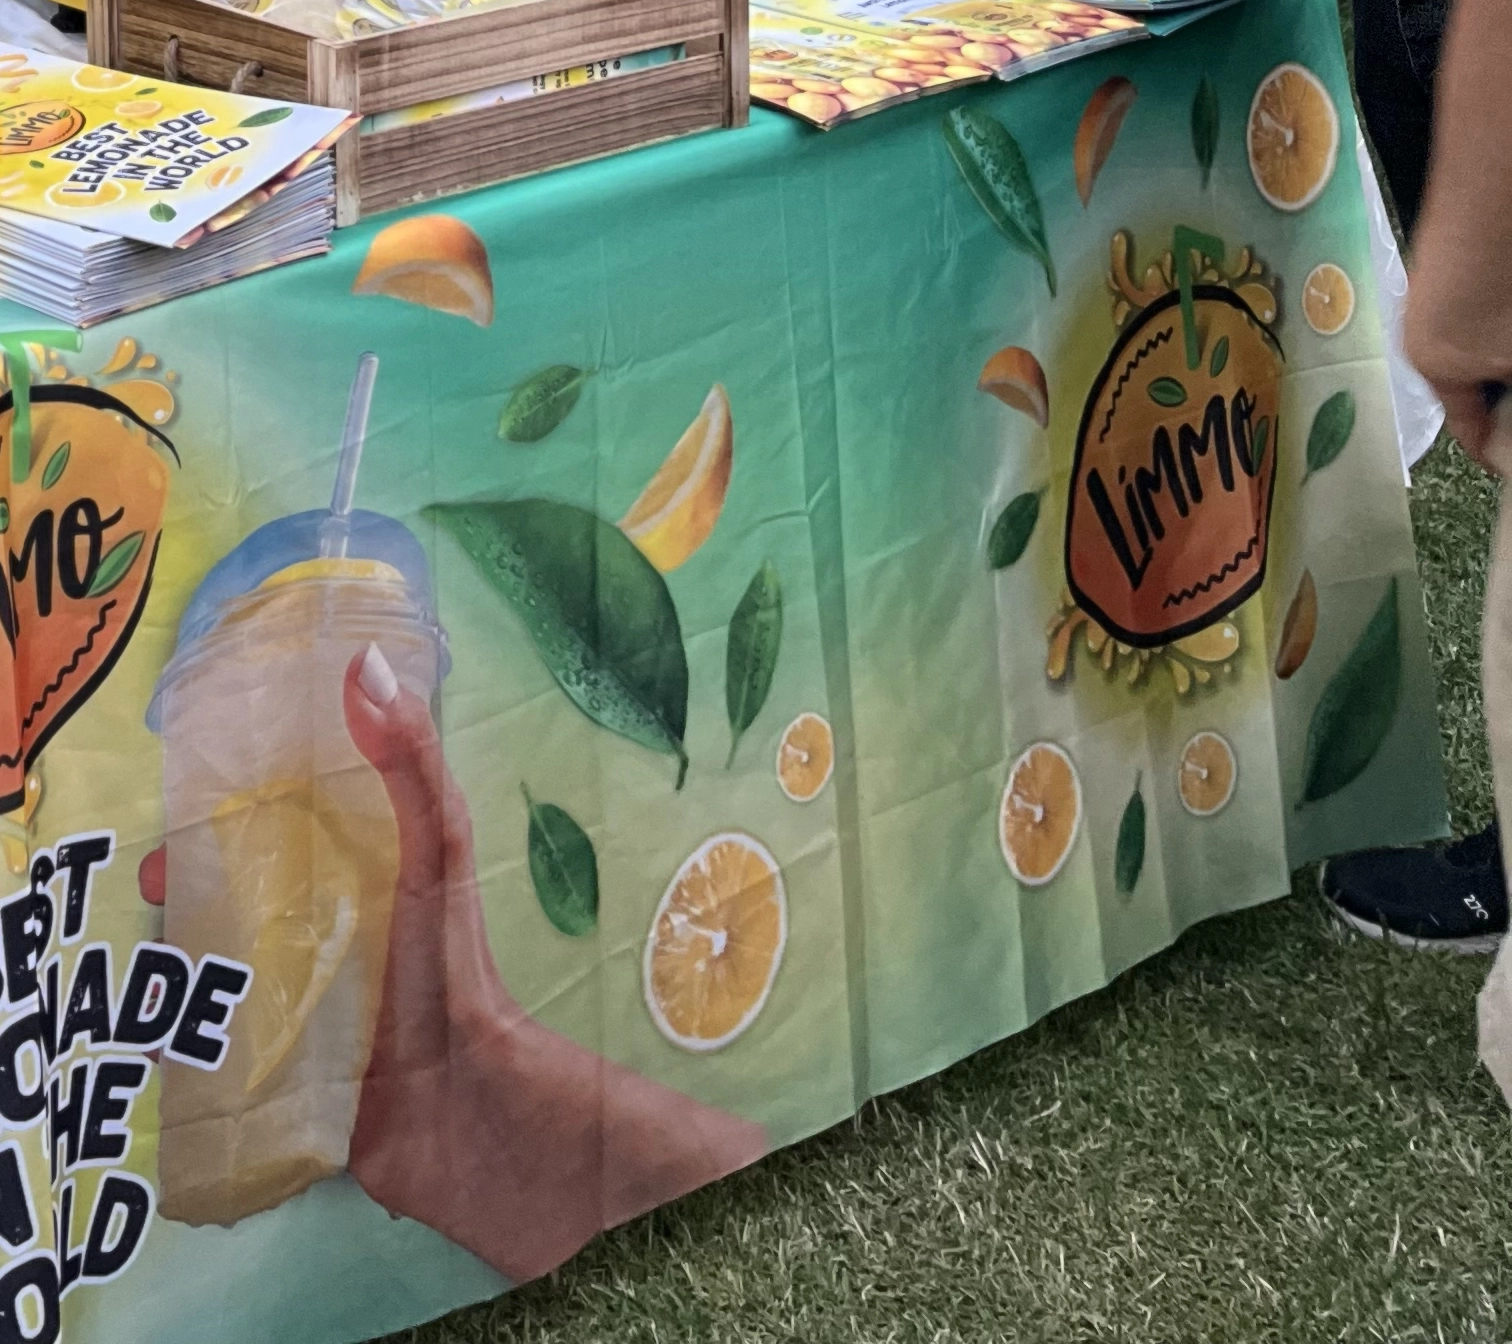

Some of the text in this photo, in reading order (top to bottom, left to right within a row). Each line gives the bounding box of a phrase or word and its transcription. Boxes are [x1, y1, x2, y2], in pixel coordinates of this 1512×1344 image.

[51, 122, 129, 162] BEST
[62, 110, 216, 194] LEMONADE
[114, 129, 212, 181] IN THE
[145, 136, 250, 192] WORLD
[48, 1062, 147, 1185] HE
